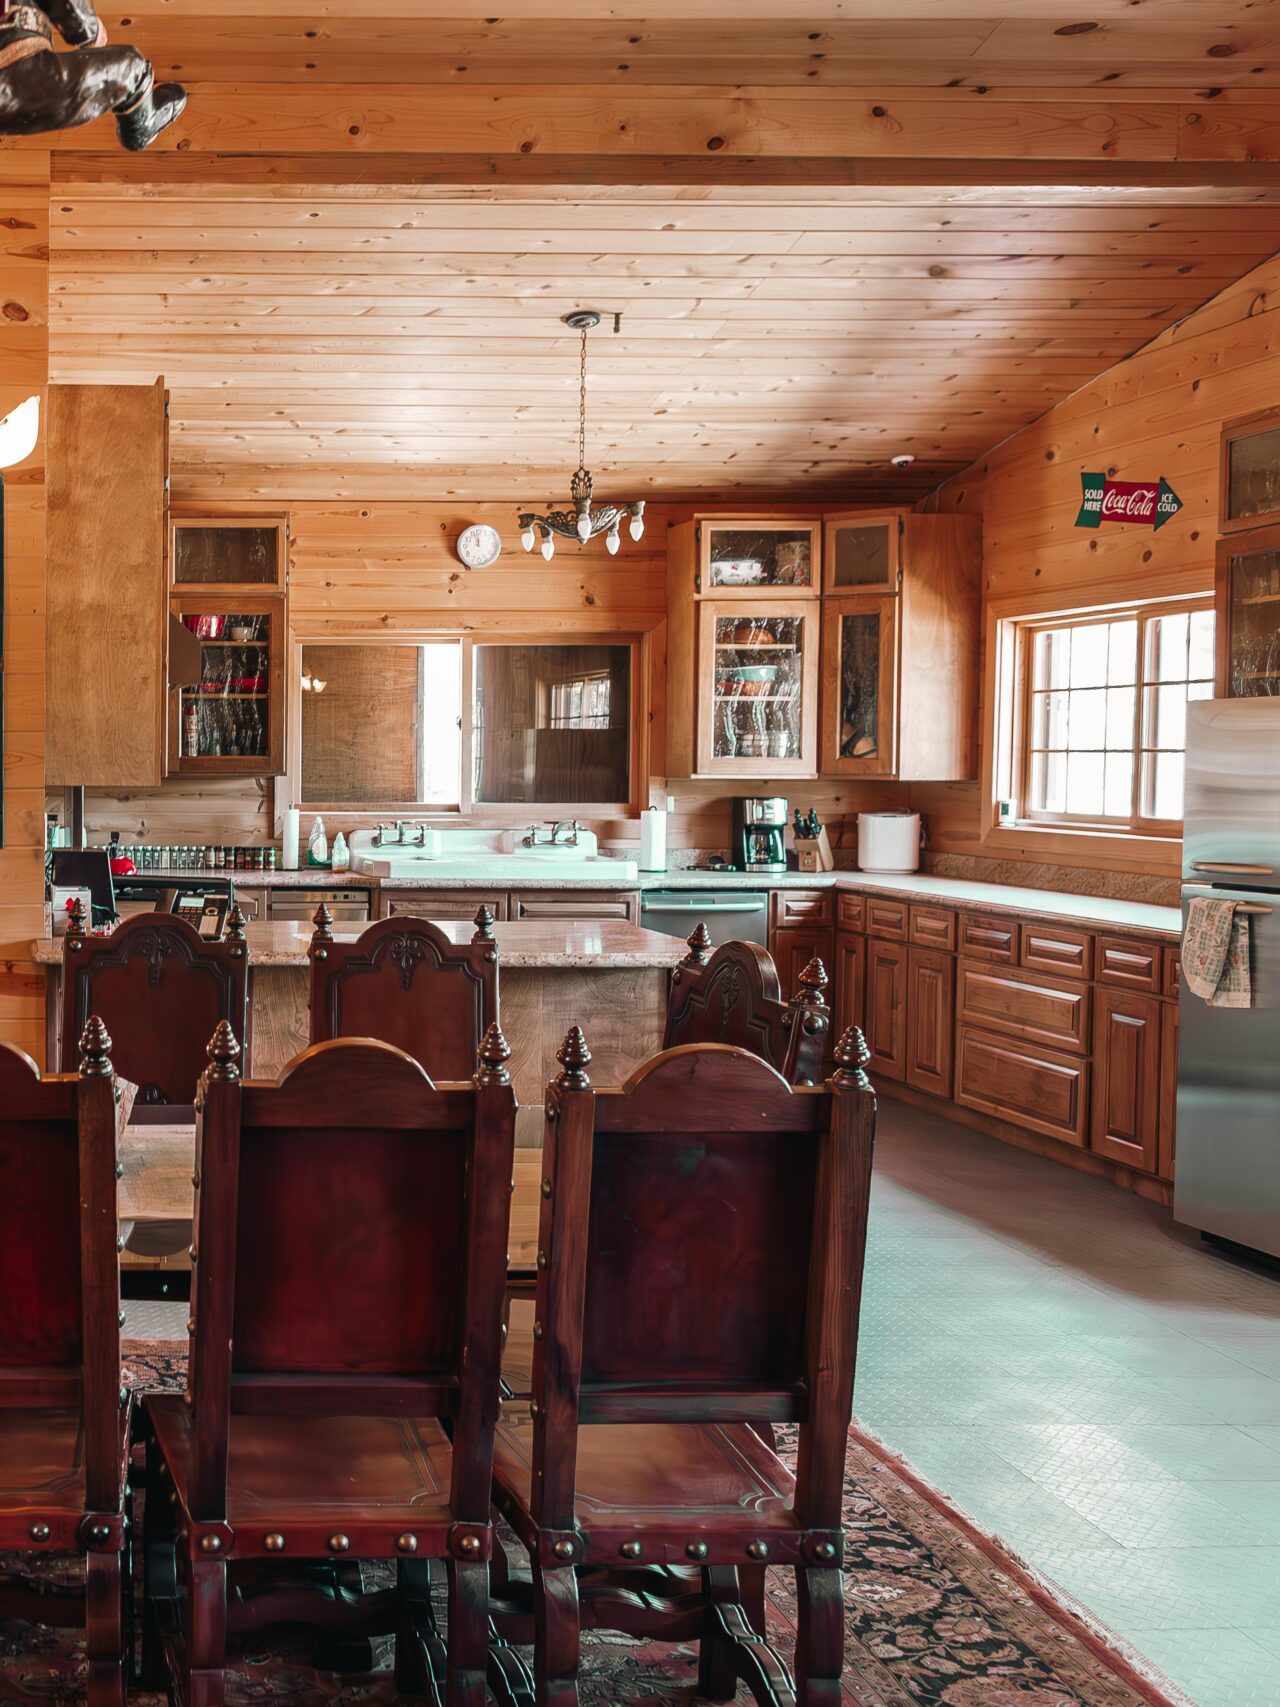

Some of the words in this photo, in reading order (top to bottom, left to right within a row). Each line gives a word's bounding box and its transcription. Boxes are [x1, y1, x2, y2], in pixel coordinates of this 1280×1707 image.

[1084, 489, 1103, 499] SOLD
[1161, 494, 1173, 503] ICE
[1084, 501, 1101, 511] HERE
[1102, 489, 1156, 516] Coca-Cola
[1157, 502, 1177, 512] COLD
